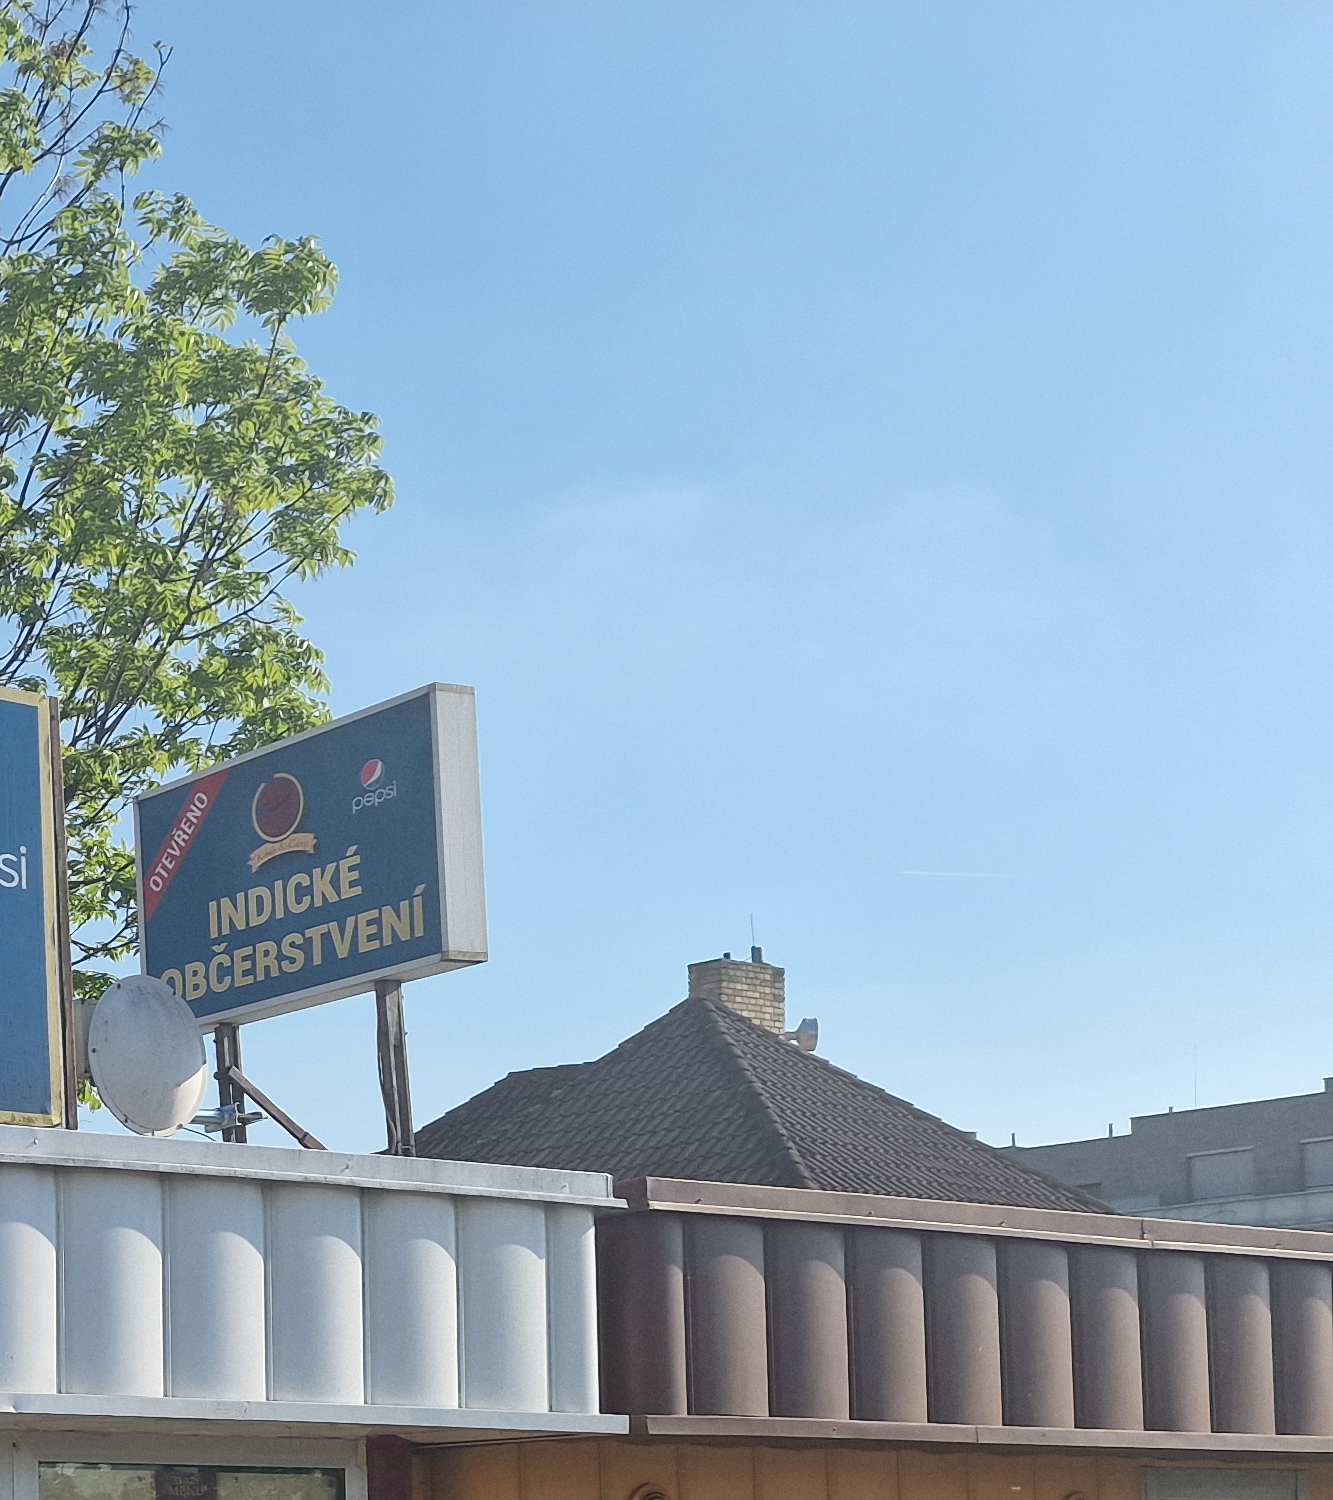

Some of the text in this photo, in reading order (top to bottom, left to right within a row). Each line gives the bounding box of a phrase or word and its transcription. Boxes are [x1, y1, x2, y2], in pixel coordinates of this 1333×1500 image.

[149, 791, 208, 892] OTEVŘENO
[352, 780, 397, 814] pepsi
[209, 845, 362, 939] INDICKÉ
[160, 884, 426, 1001] OBČERSTVENÍ
